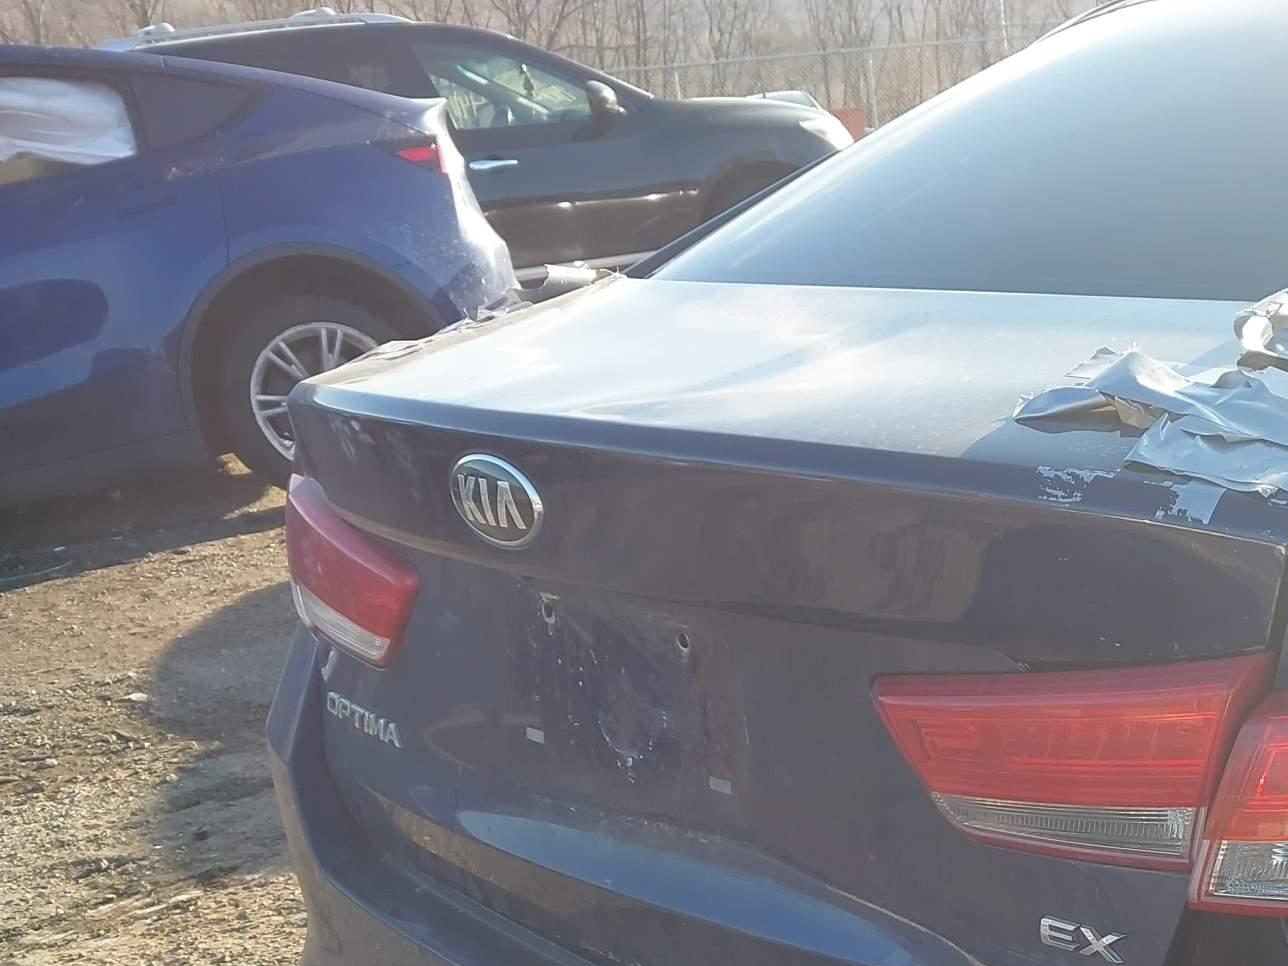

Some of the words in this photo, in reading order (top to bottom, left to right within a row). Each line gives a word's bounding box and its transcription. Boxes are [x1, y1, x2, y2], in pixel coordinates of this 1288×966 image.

[457, 473, 527, 530] KIA
[326, 691, 401, 748] OPTIMA
[1040, 914, 1128, 964] EX
